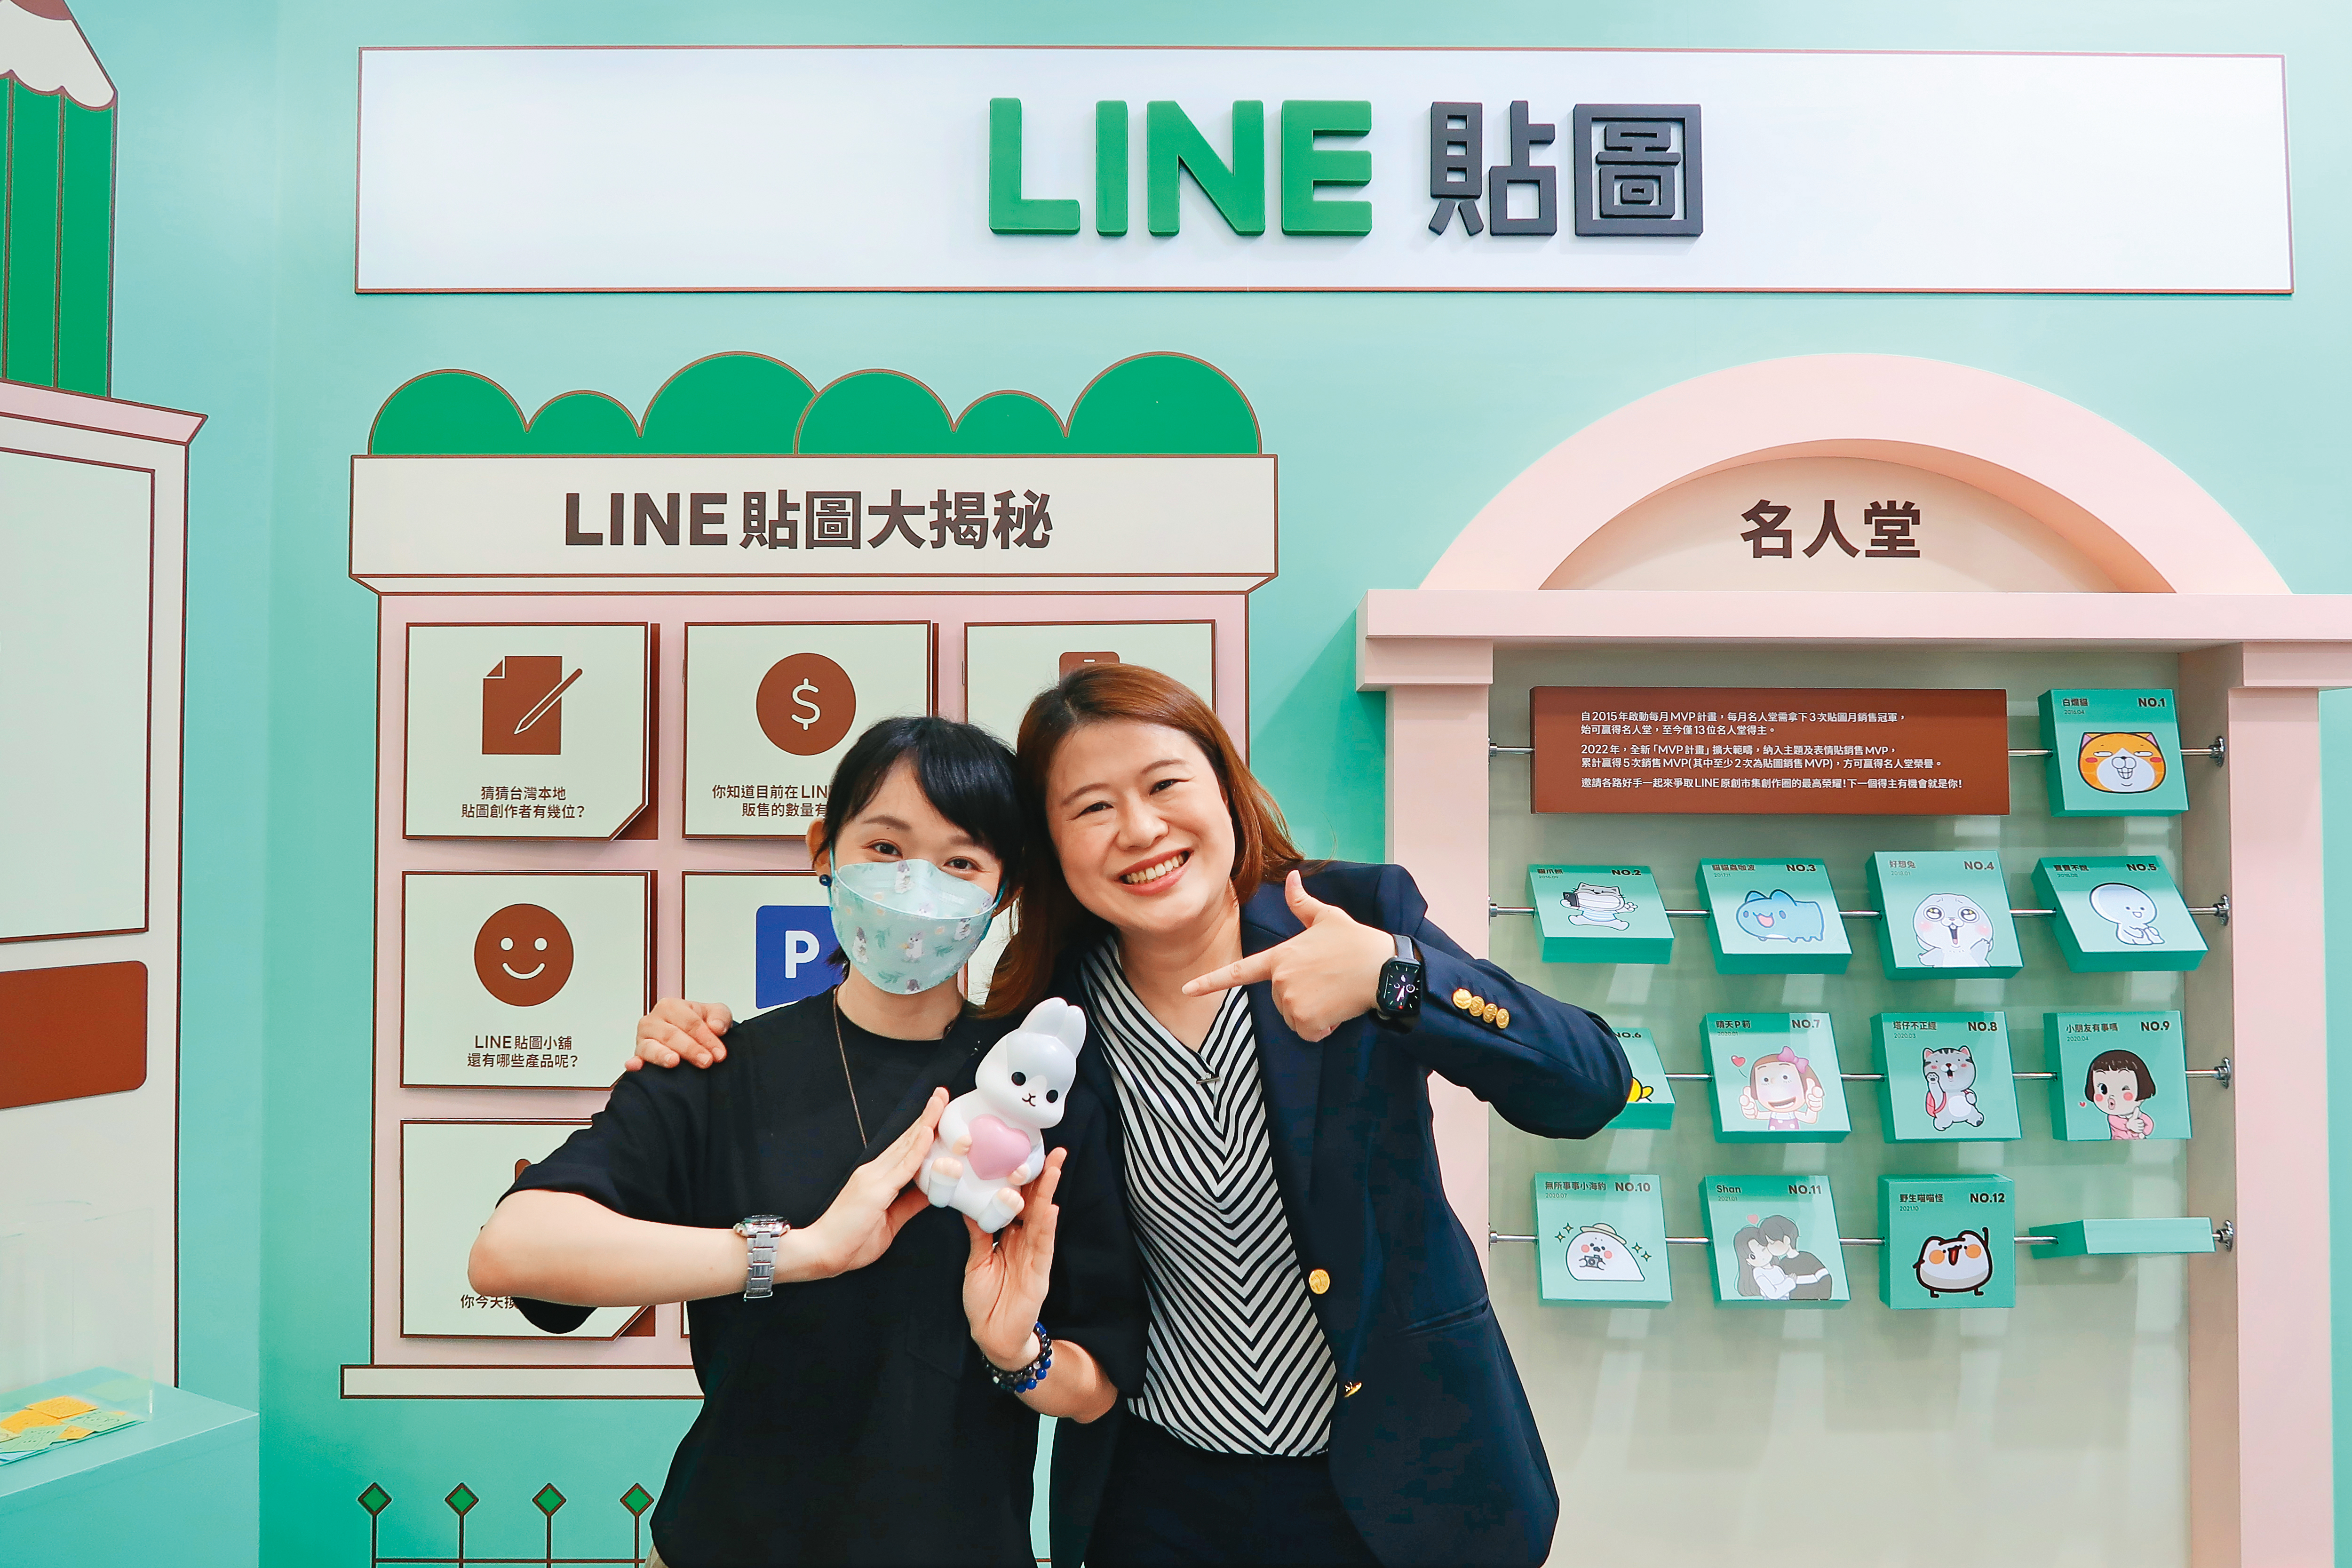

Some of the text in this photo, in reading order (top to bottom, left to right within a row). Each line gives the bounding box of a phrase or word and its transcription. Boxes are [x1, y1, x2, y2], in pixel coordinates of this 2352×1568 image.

[988, 97, 1704, 237] LINE 貼圖
[1740, 499, 1920, 559] 名人堂
[2138, 698, 2165, 707] NO.1
[481, 786, 566, 801] 猜猜台灣本地
[1889, 860, 1916, 868] 好想兔
[1964, 861, 1994, 870] NO.4
[2127, 863, 2157, 871] NO.5
[1791, 1019, 1820, 1029] NO.7
[1968, 1020, 1997, 1032] NO.8
[2066, 1023, 2118, 1033] 小朋友有事嗎
[2140, 1020, 2170, 1032] NO.9
[1545, 1181, 1606, 1191] 無所事事小海豹
[1614, 1182, 1651, 1192] NO.10
[1716, 1185, 1741, 1193] Shan
[1788, 1185, 1822, 1194] NO.11
[1899, 1194, 1943, 1203] 野生喵喵怪
[1970, 1193, 2005, 1203] NO.12
